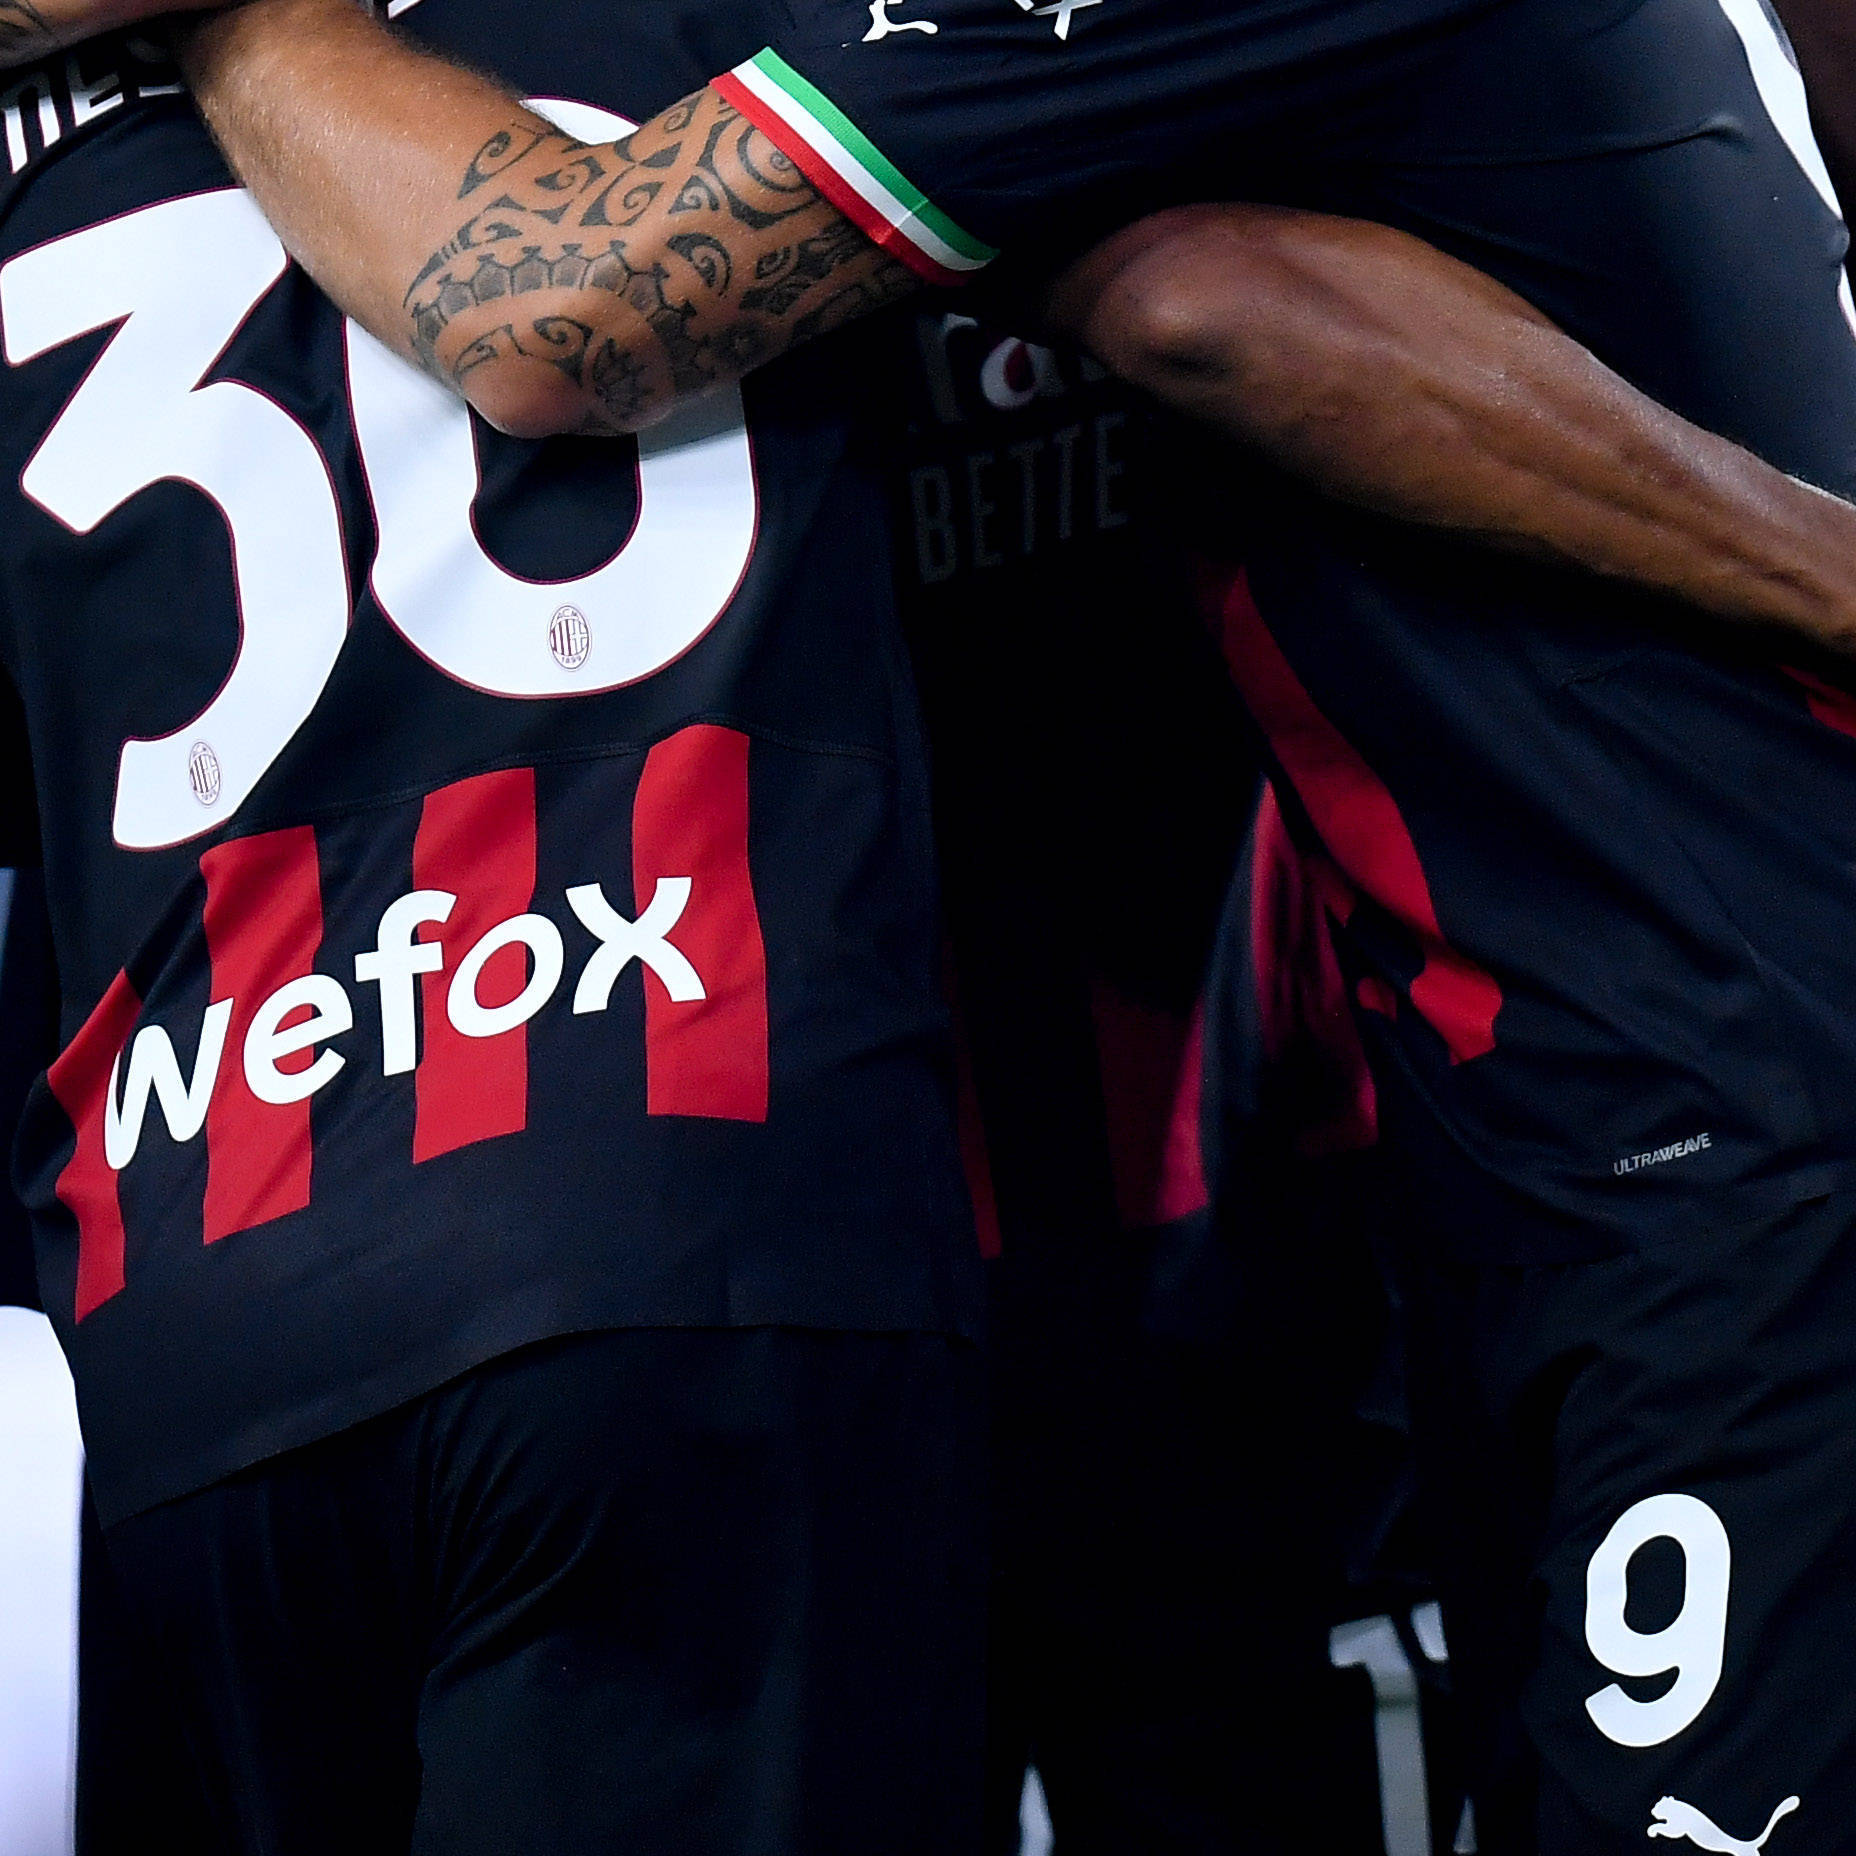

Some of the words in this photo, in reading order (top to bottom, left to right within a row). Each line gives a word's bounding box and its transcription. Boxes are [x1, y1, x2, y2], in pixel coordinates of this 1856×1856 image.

[908, 408, 1129, 584] BETTE
[104, 876, 707, 1171] wefox
[1613, 1132, 1713, 1176] ULTRAWEAVE
[1584, 1493, 1731, 1748] 9
